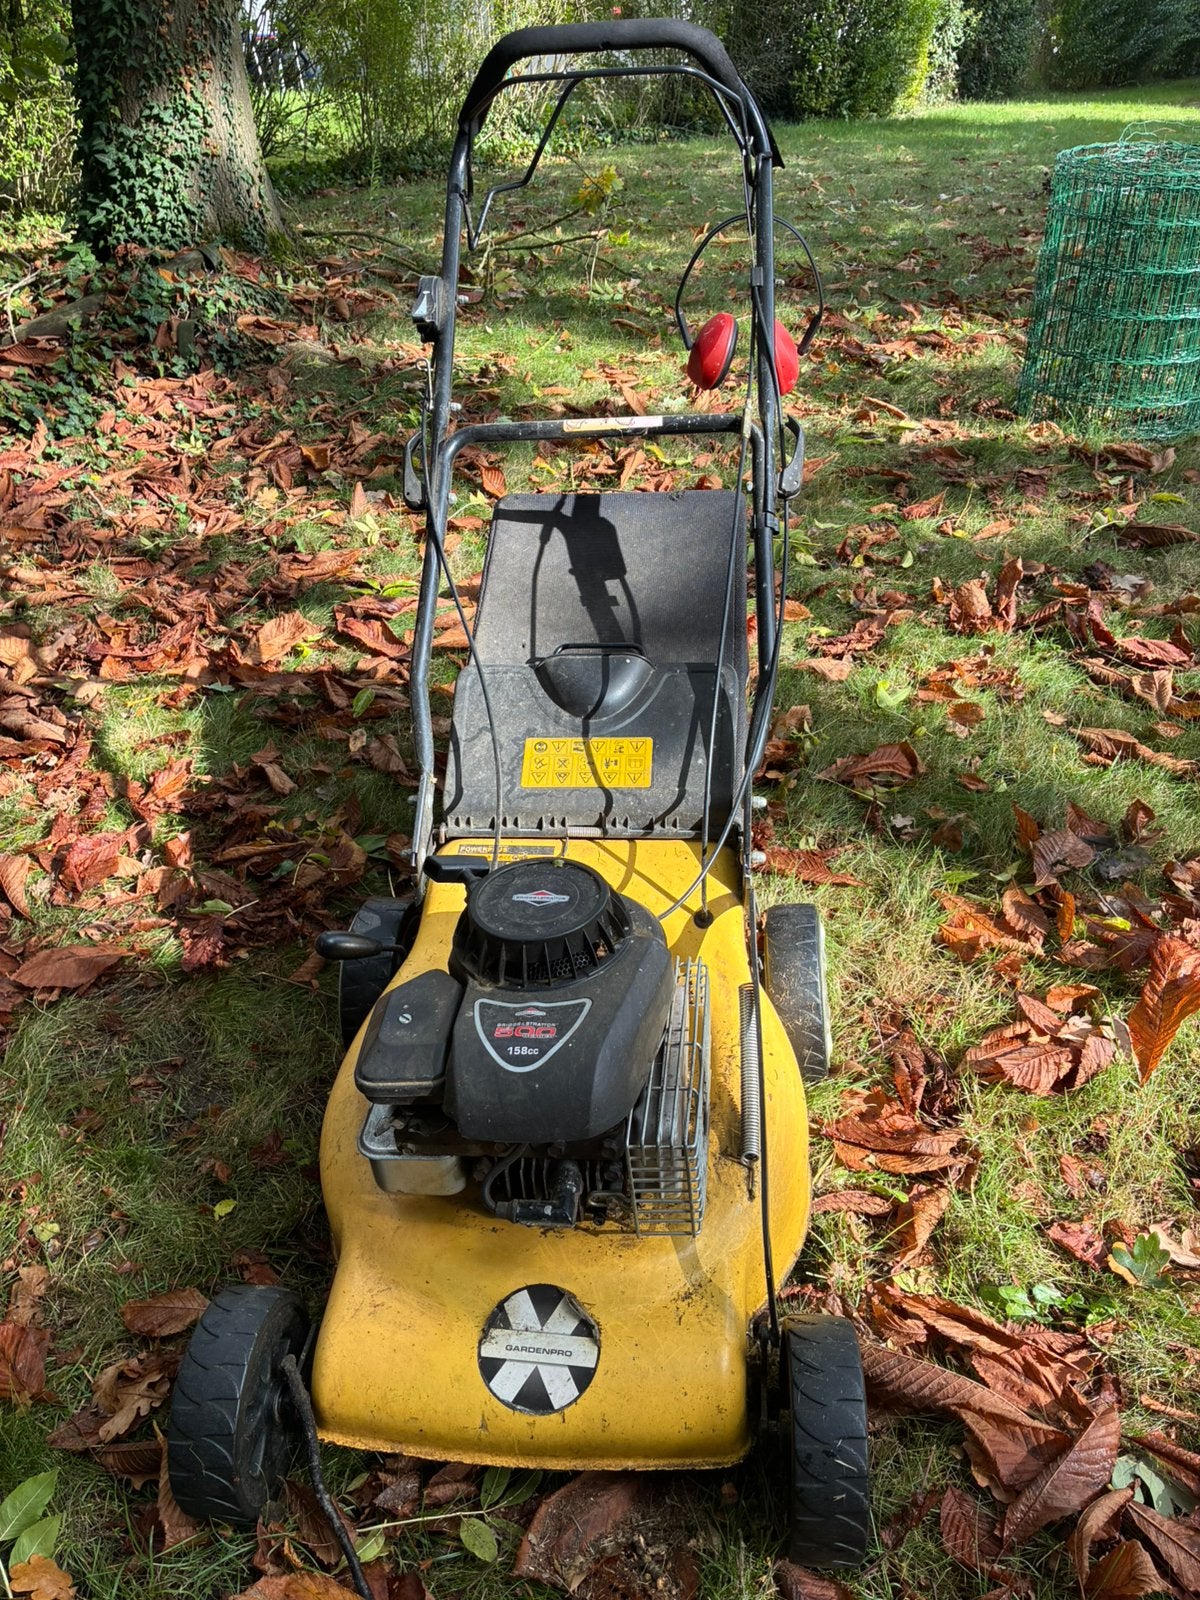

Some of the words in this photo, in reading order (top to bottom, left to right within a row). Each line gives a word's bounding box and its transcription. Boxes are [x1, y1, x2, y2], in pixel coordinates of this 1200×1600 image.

[460, 846, 508, 854] POWERPUS
[494, 1025, 557, 1038] 500
[507, 1046, 539, 1055] 158cc
[505, 1344, 573, 1357] GARDENPRO
